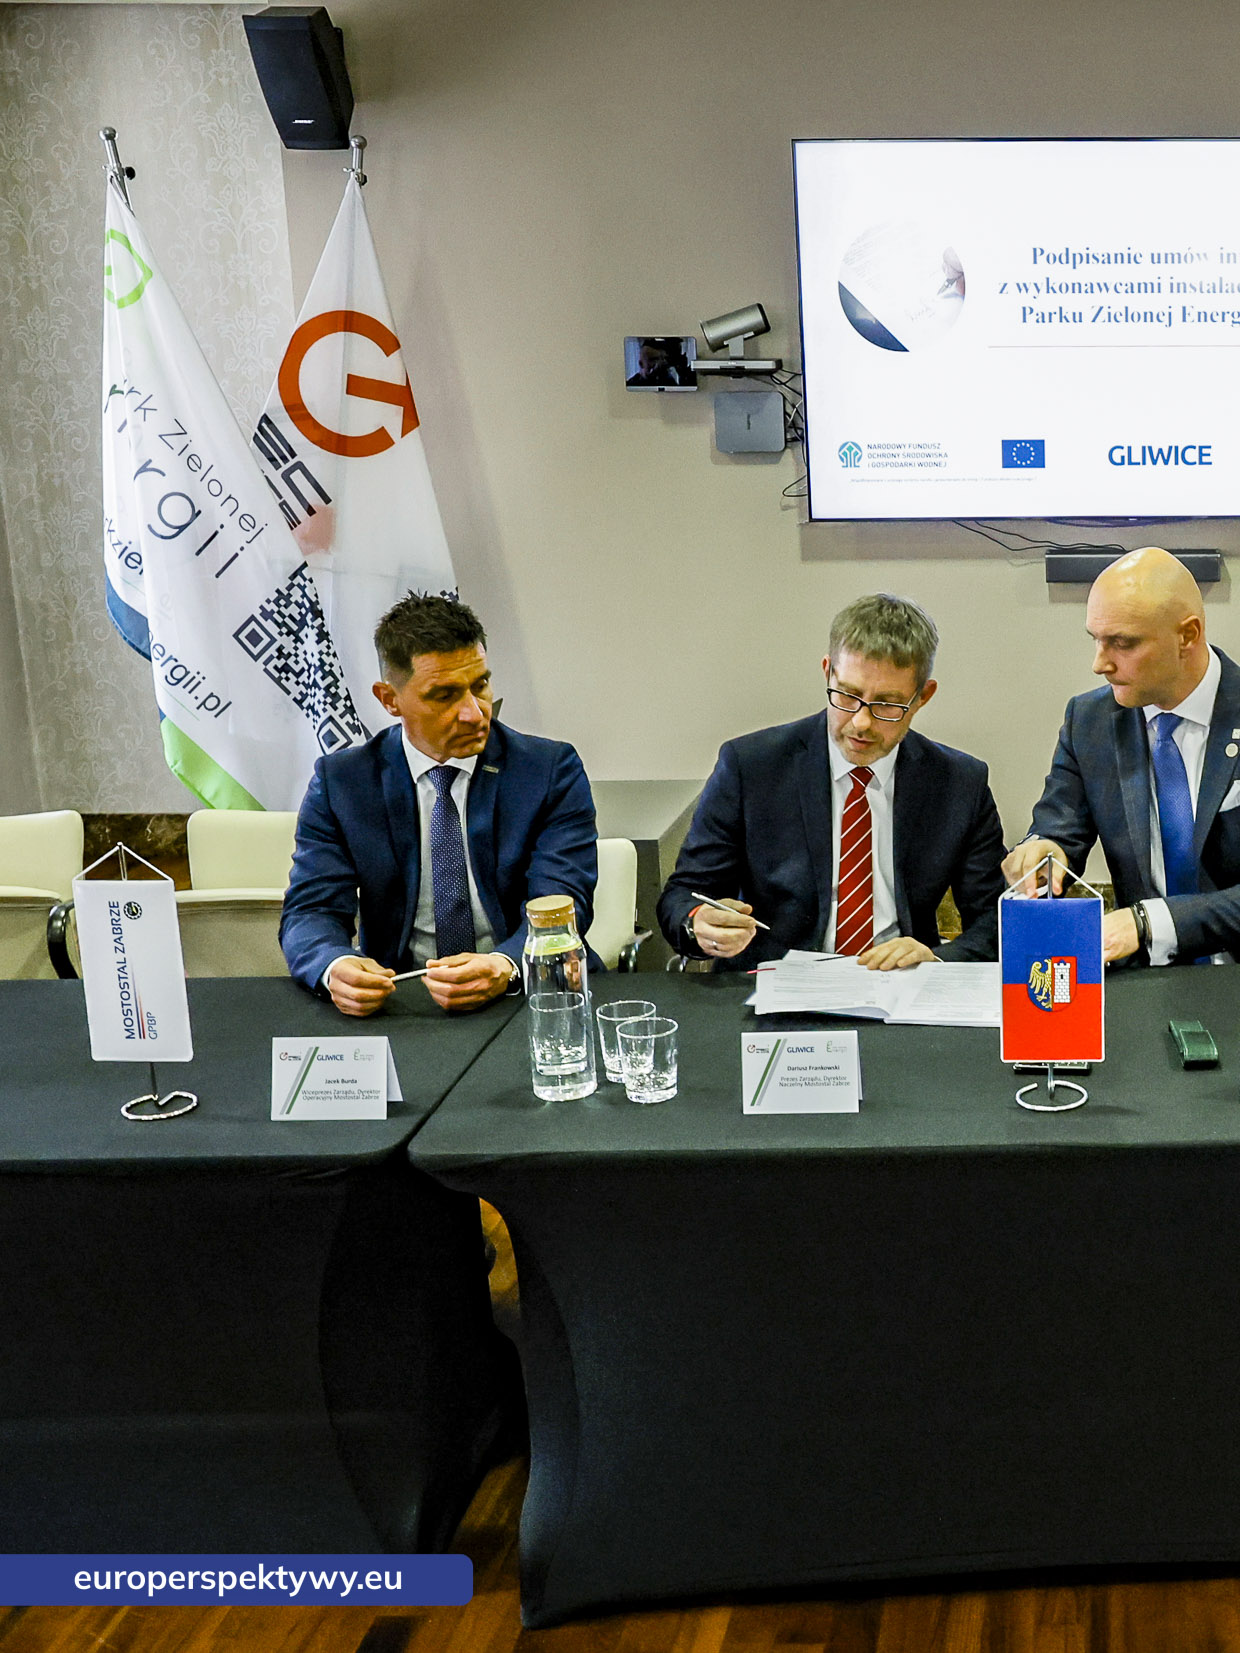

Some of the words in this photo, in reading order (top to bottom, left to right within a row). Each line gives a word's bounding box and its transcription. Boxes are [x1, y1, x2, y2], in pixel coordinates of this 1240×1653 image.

[1031, 246, 1144, 270] Podpisanie
[1150, 246, 1209, 266] umów
[998, 281, 1009, 295] z
[1015, 276, 1162, 299] wykonawcami
[1020, 305, 1084, 324] Parku
[1090, 305, 1173, 328] Zielonej
[902, 450, 949, 459] ŚRODOWISKA
[1107, 443, 1213, 467] GLIWICE
[158, 418, 269, 544] Zielonej
[108, 900, 126, 954] ZABRZE
[116, 957, 136, 1040] MOSTOSTAL
